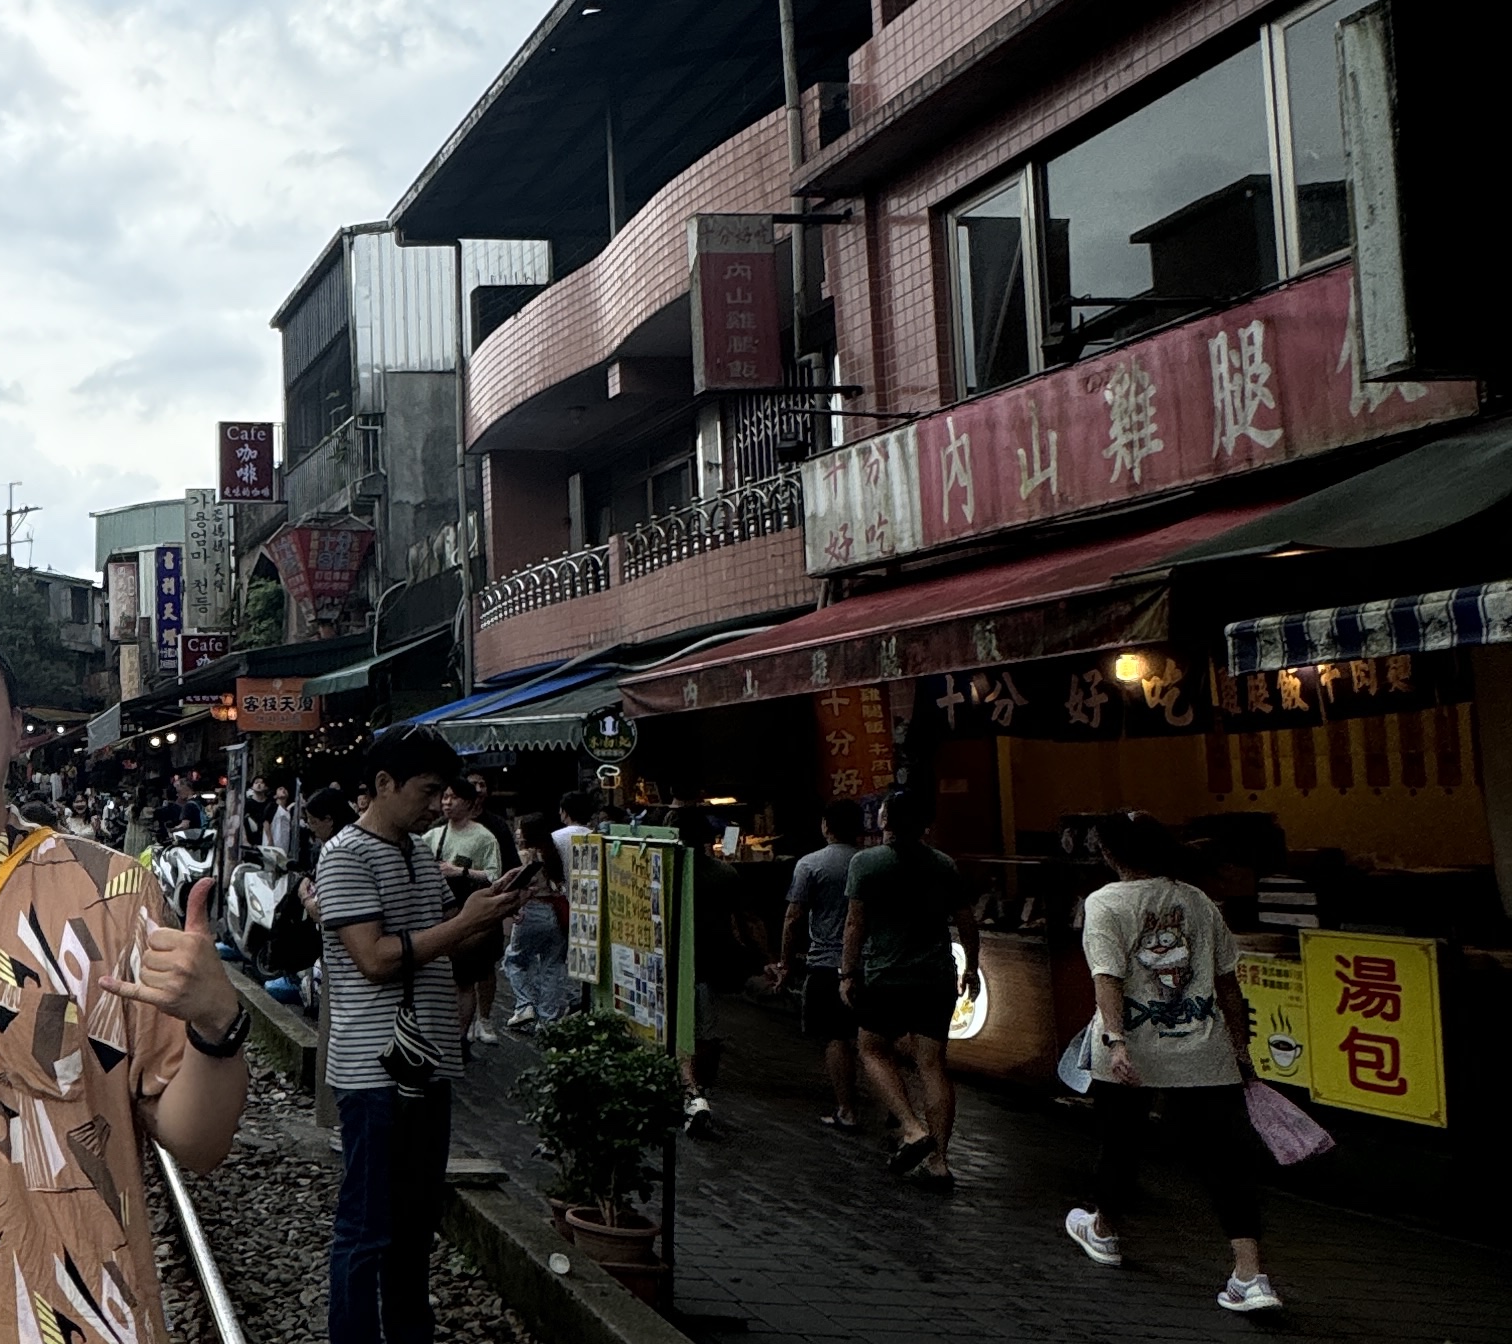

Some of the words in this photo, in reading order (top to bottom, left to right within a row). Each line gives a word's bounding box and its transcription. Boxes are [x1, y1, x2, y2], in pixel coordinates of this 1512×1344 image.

[226, 425, 267, 442] Cafe
[235, 444, 258, 485] 咖啡
[823, 440, 890, 501] 十分
[189, 493, 211, 564] 가용엄마
[211, 494, 226, 554] 容媽媽
[824, 512, 896, 567] 好吃
[191, 578, 211, 614] 천등
[187, 637, 224, 652] Cafe
[935, 657, 1194, 731] 十分好吃
[1334, 955, 1407, 1096] 湯包
